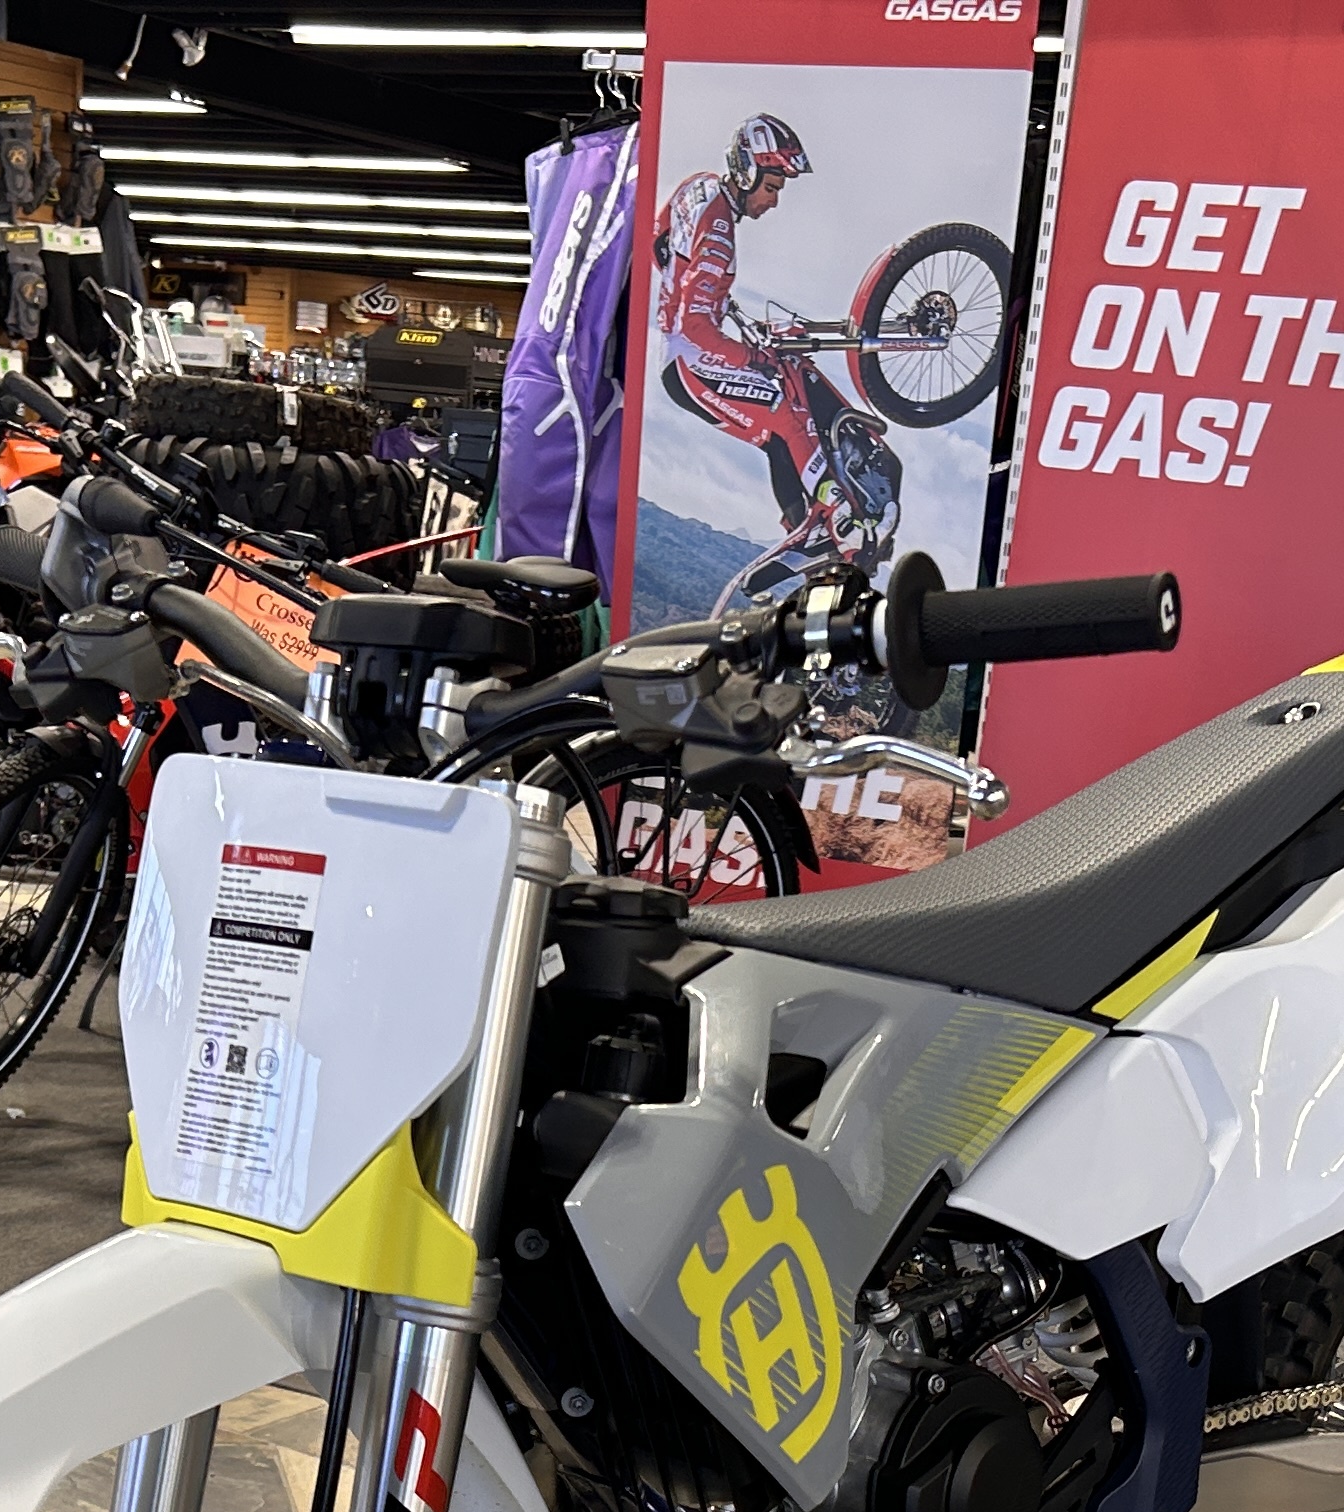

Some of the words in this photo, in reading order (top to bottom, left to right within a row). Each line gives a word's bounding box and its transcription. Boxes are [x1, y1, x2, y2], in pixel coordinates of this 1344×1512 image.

[884, 0, 1021, 22] GASGAS
[1103, 179, 1308, 276] GET
[1069, 283, 1222, 378] ON
[701, 390, 754, 428] GASGAS
[717, 380, 774, 402] hebo
[1037, 385, 1273, 488] GAS!
[256, 593, 316, 632] Crosse
[251, 618, 277, 646] Was
[278, 631, 320, 662] $2999
[257, 852, 295, 867] WARNING
[616, 800, 768, 888] GAS
[224, 923, 277, 942] COMPETITION
[277, 930, 302, 944] ONLY
